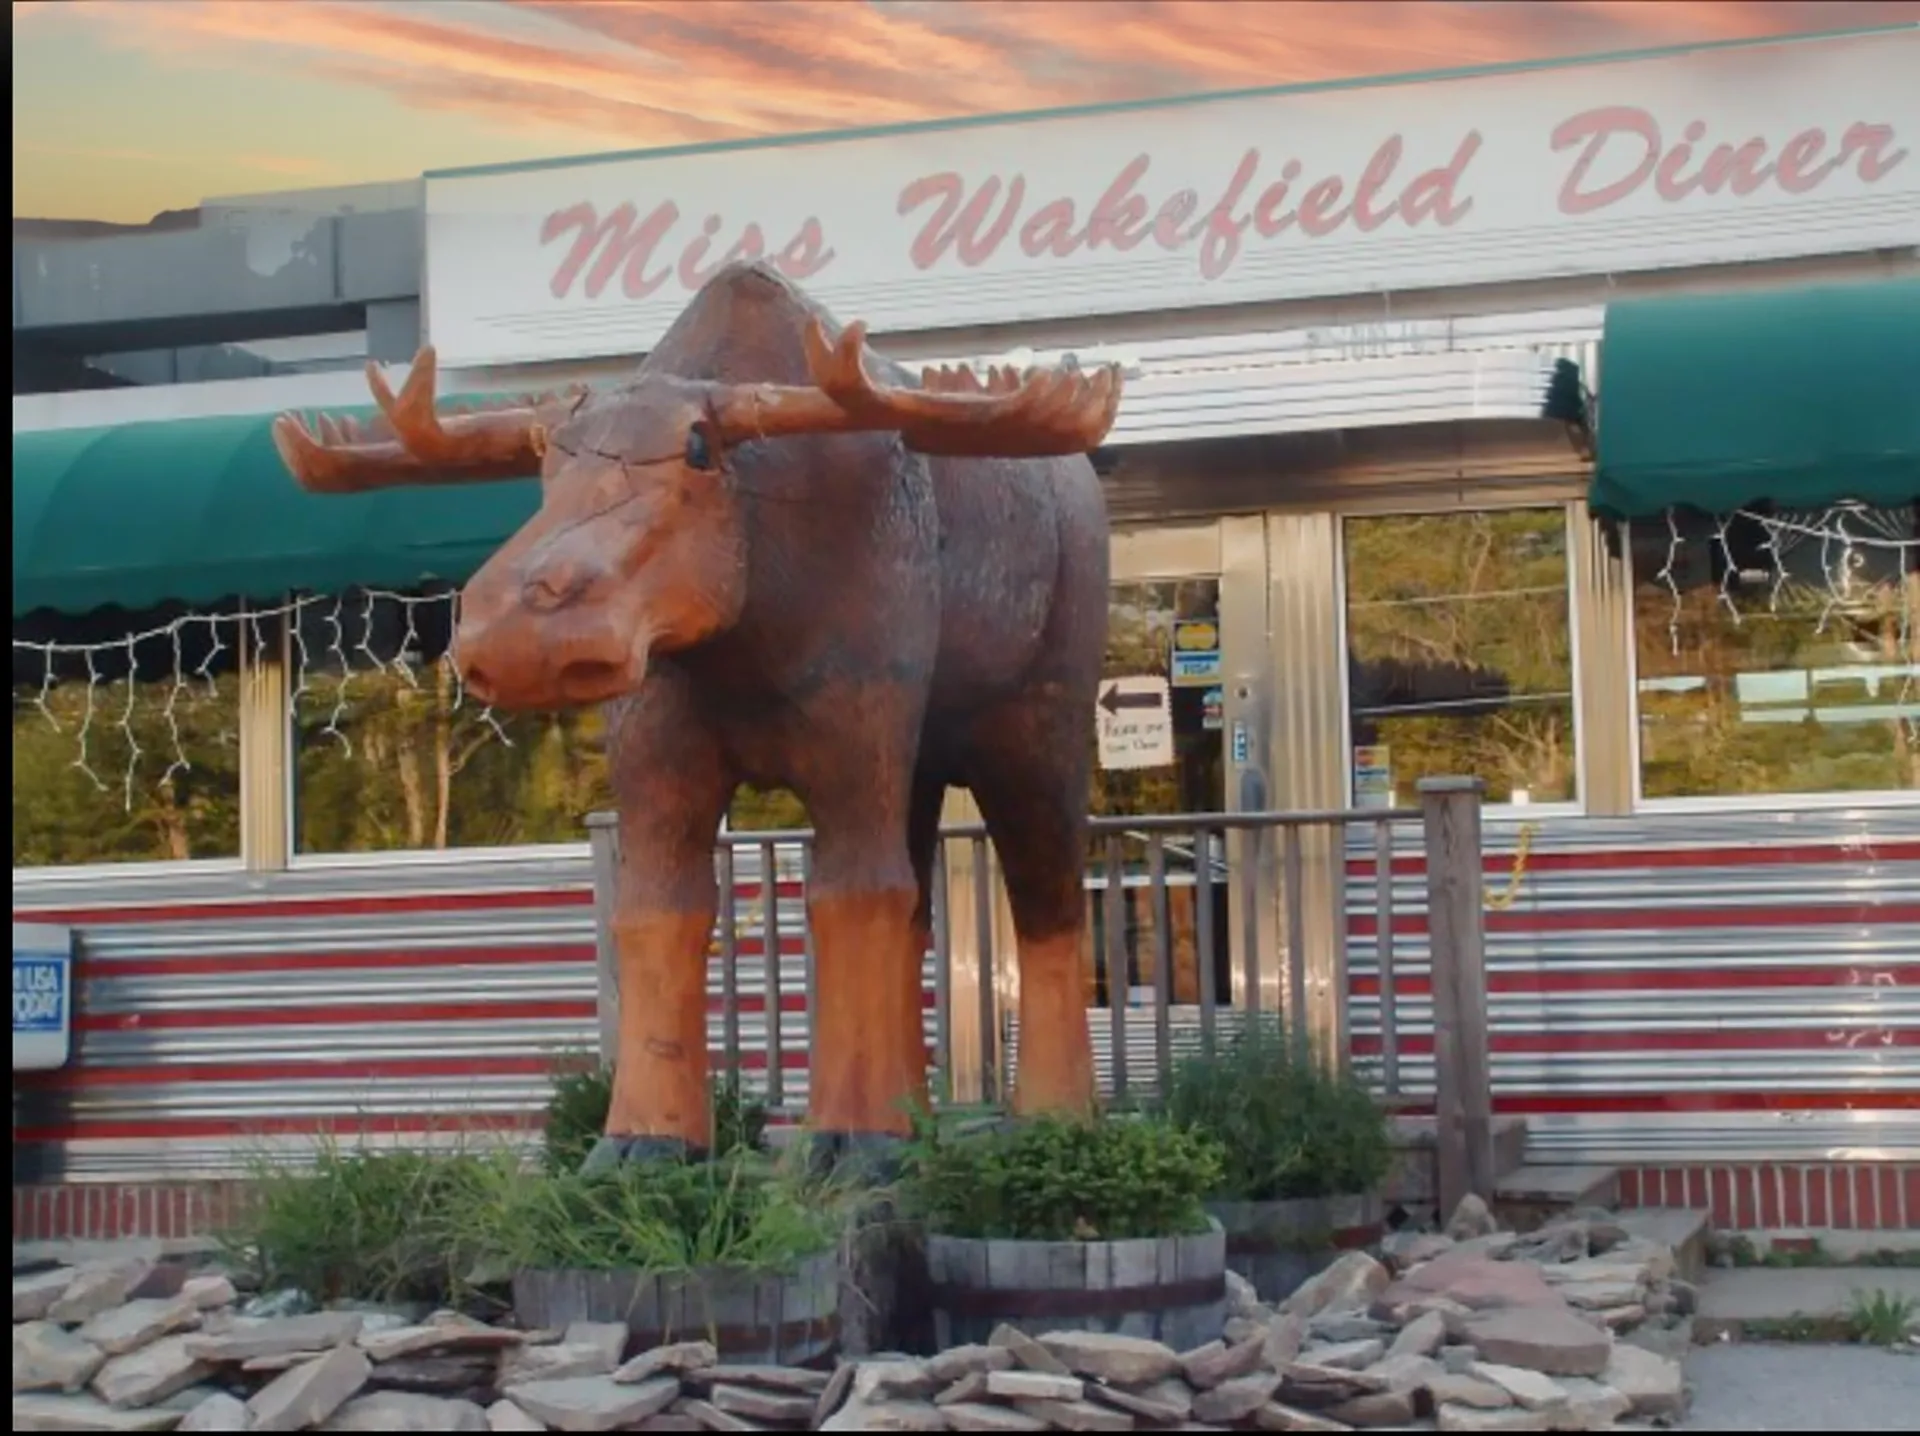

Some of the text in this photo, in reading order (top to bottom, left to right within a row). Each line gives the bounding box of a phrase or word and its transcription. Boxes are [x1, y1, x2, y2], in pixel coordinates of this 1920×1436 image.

[539, 105, 1908, 300] Miss Wakefield Diner
[27, 965, 59, 991] USA
[13, 991, 63, 1021] ODAY
